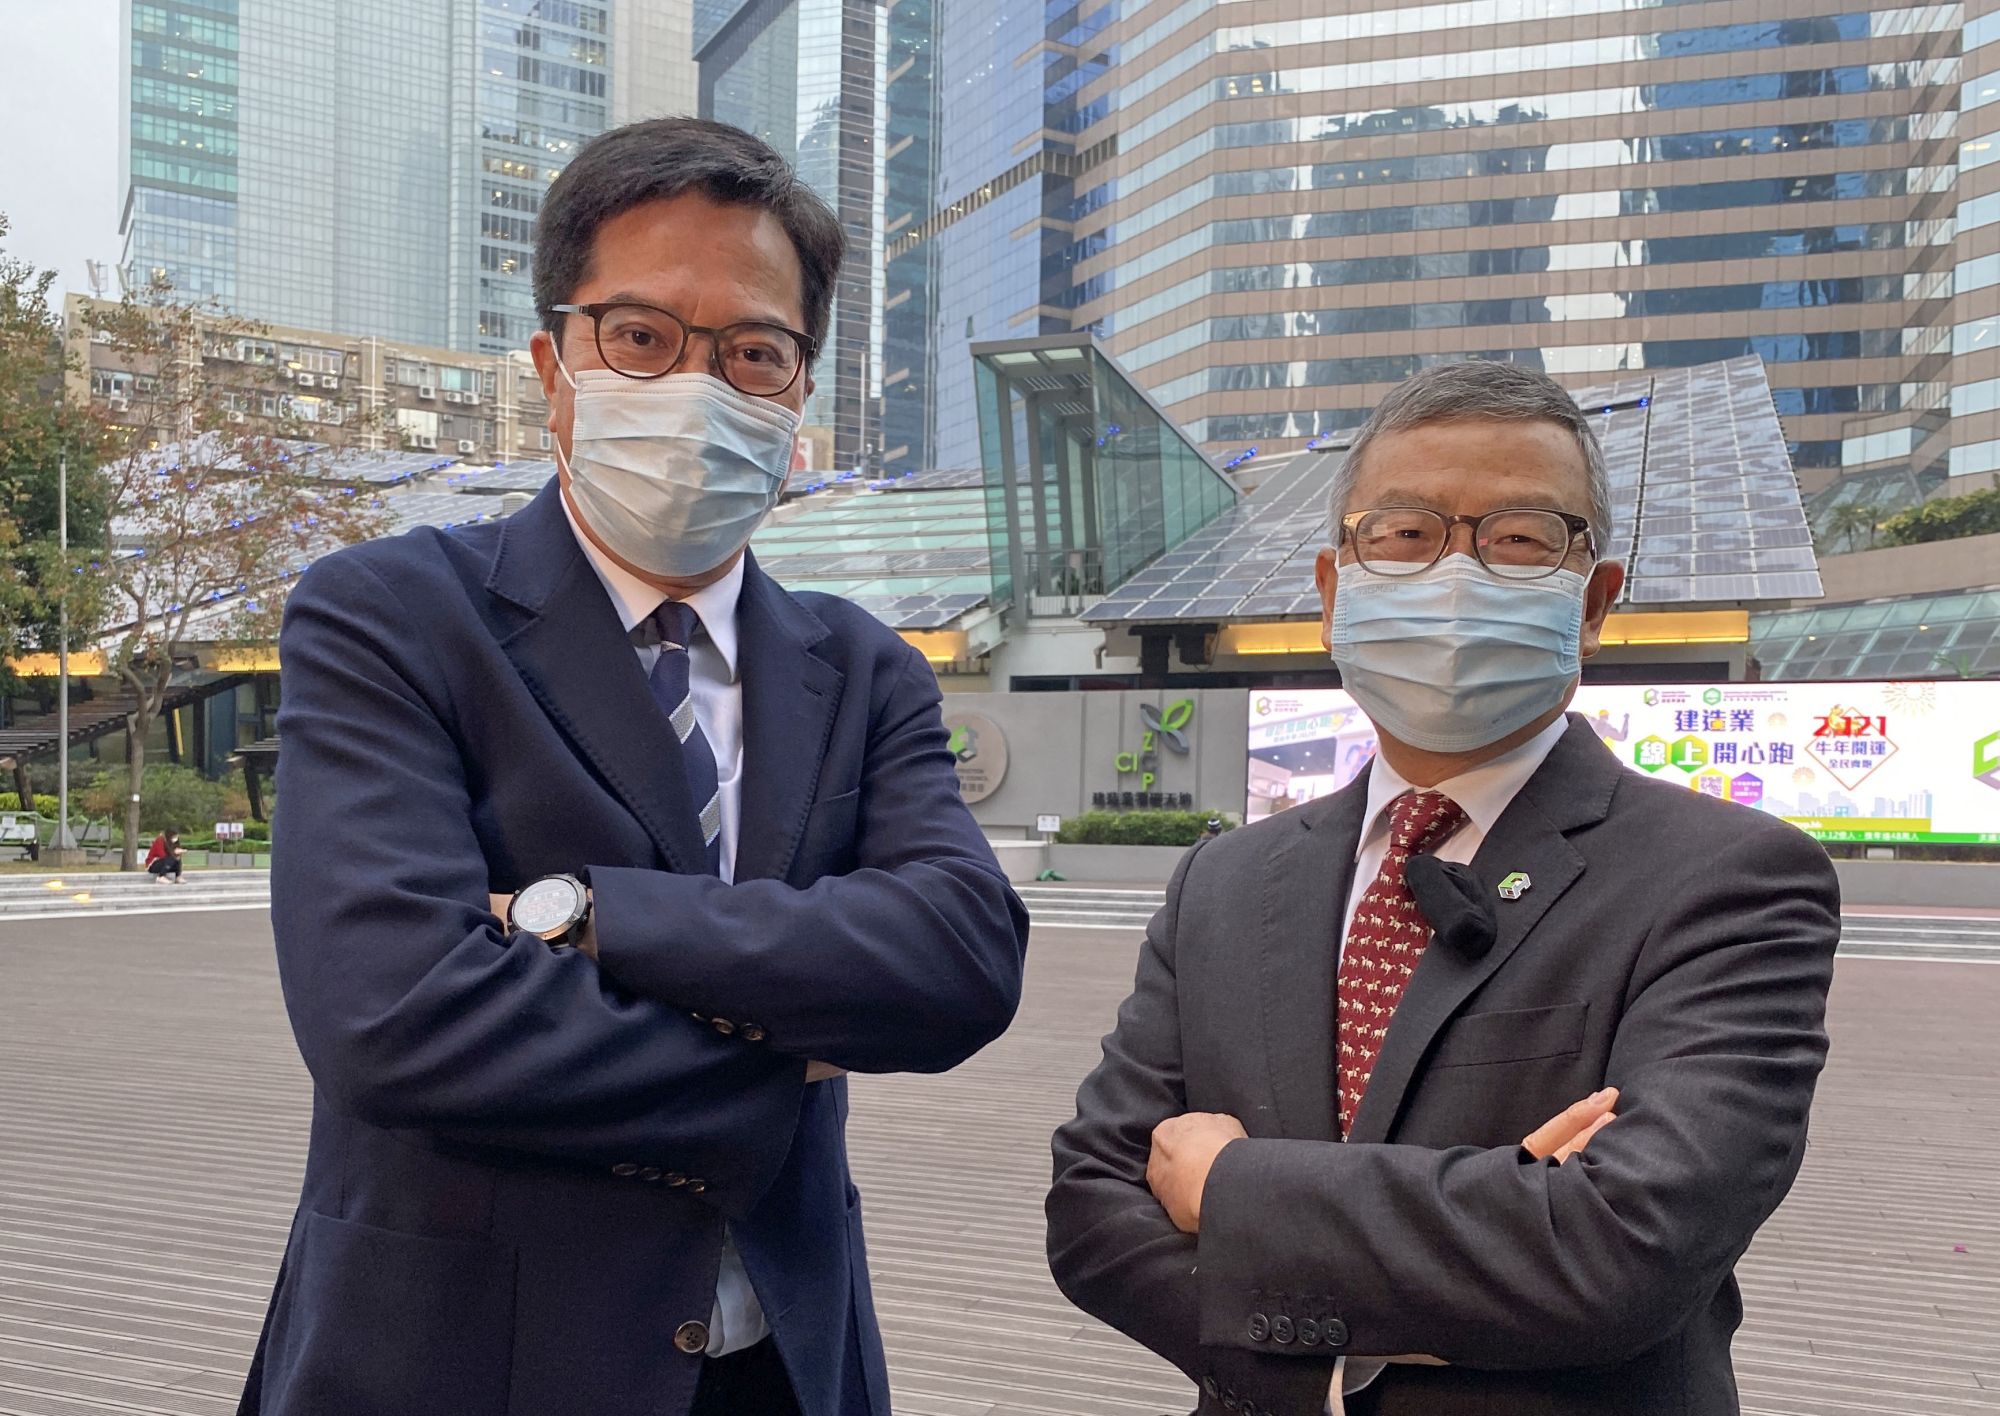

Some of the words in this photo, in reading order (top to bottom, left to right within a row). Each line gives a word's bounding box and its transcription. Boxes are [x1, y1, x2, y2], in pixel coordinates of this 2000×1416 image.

[1675, 709, 1754, 732] 建造業
[1815, 740, 1886, 755] 牛年開運
